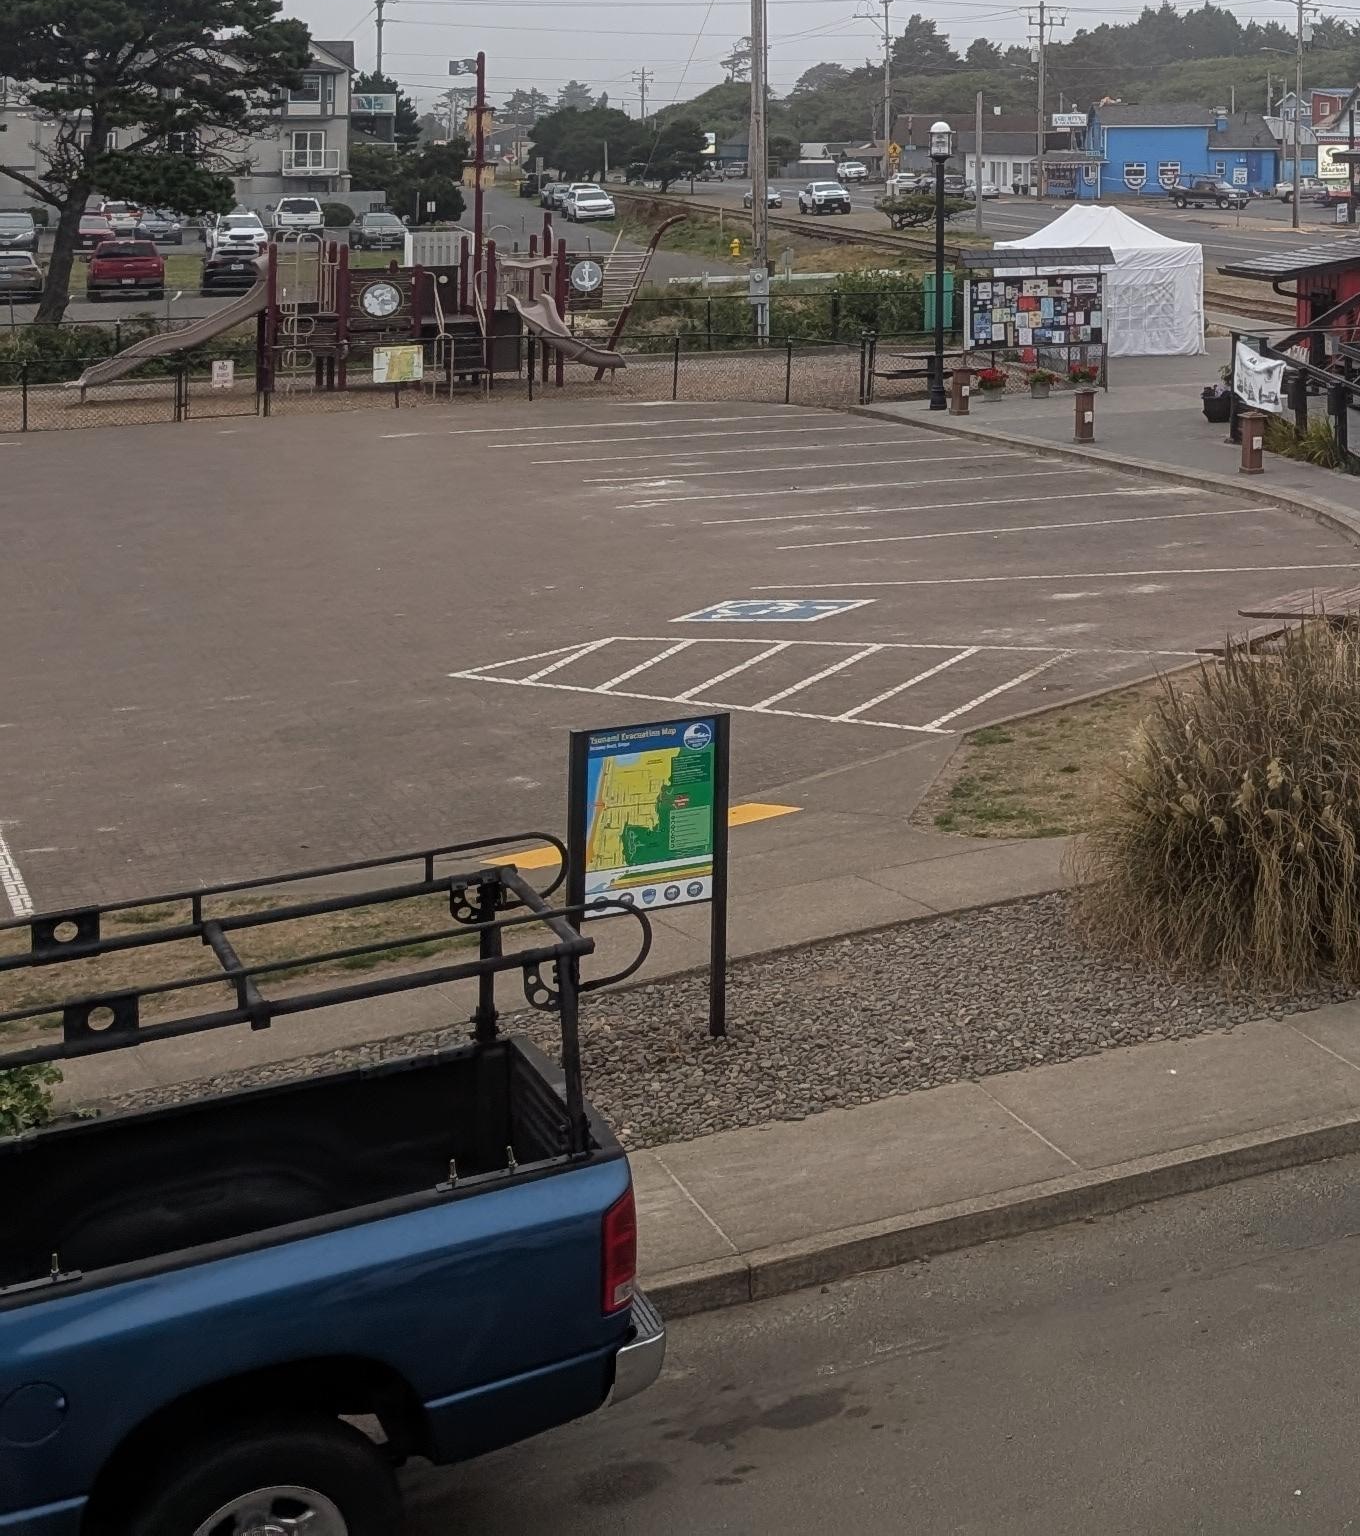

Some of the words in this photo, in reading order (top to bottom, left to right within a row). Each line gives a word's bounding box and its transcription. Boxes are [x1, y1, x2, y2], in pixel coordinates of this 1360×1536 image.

[590, 733, 620, 745] Tsunami
[621, 729, 661, 742] Evacuation
[661, 727, 677, 737] Map
